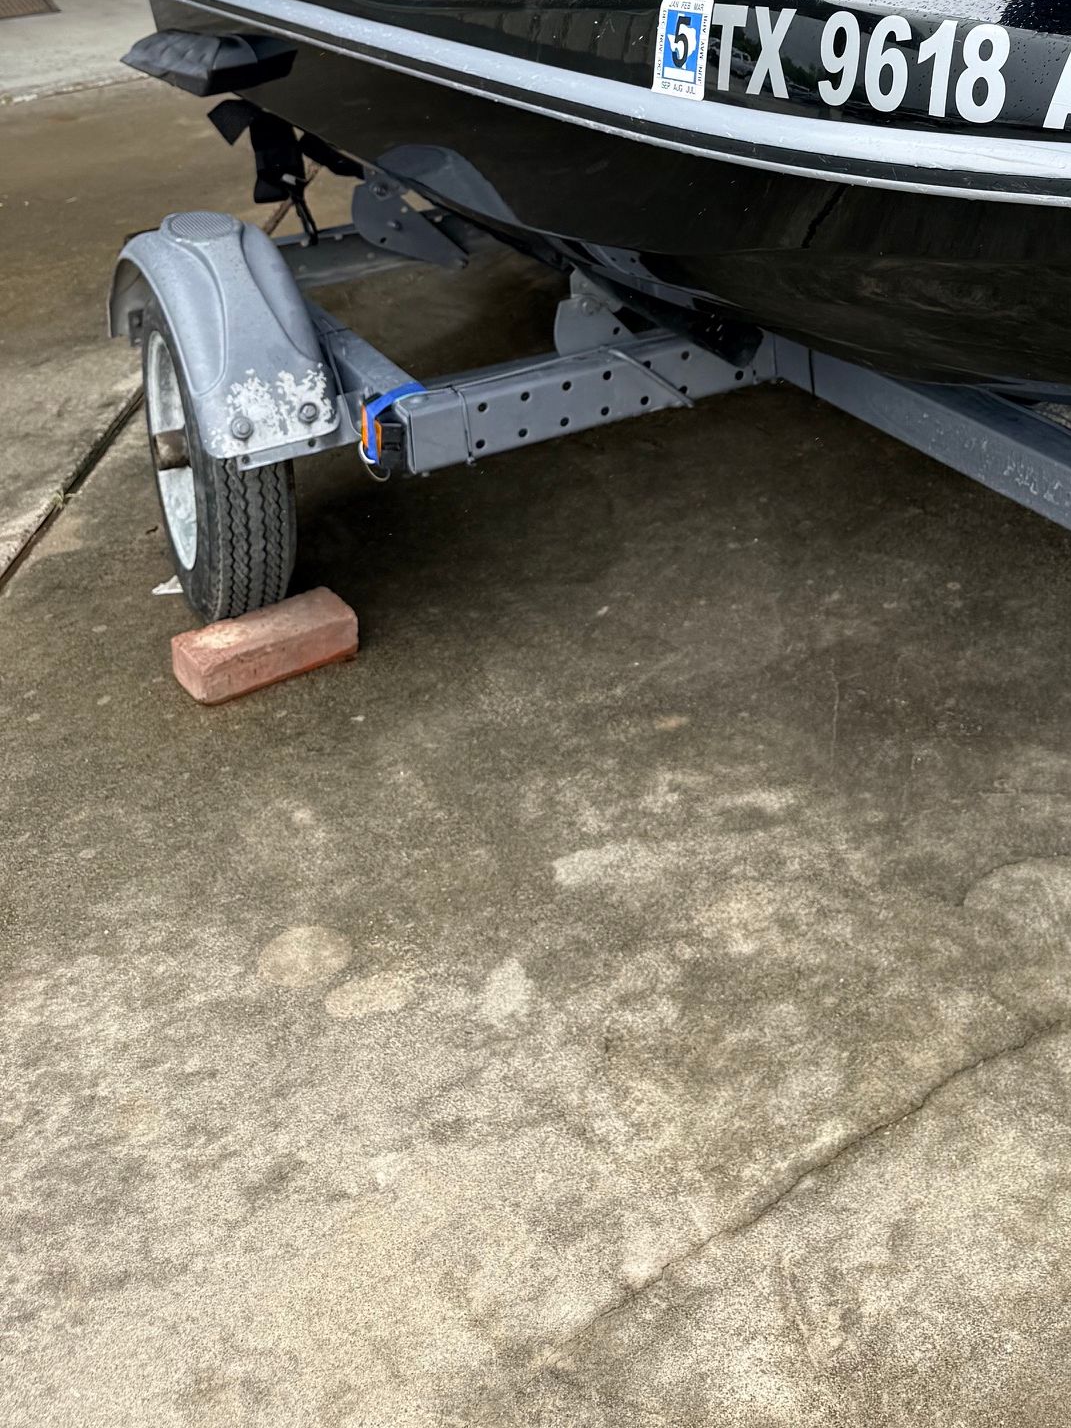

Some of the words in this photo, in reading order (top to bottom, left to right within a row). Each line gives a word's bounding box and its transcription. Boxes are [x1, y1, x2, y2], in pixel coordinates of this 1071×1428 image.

[672, 15, 692, 69] 5
[711, 4, 798, 99] TX
[817, 10, 1010, 124] 9618
